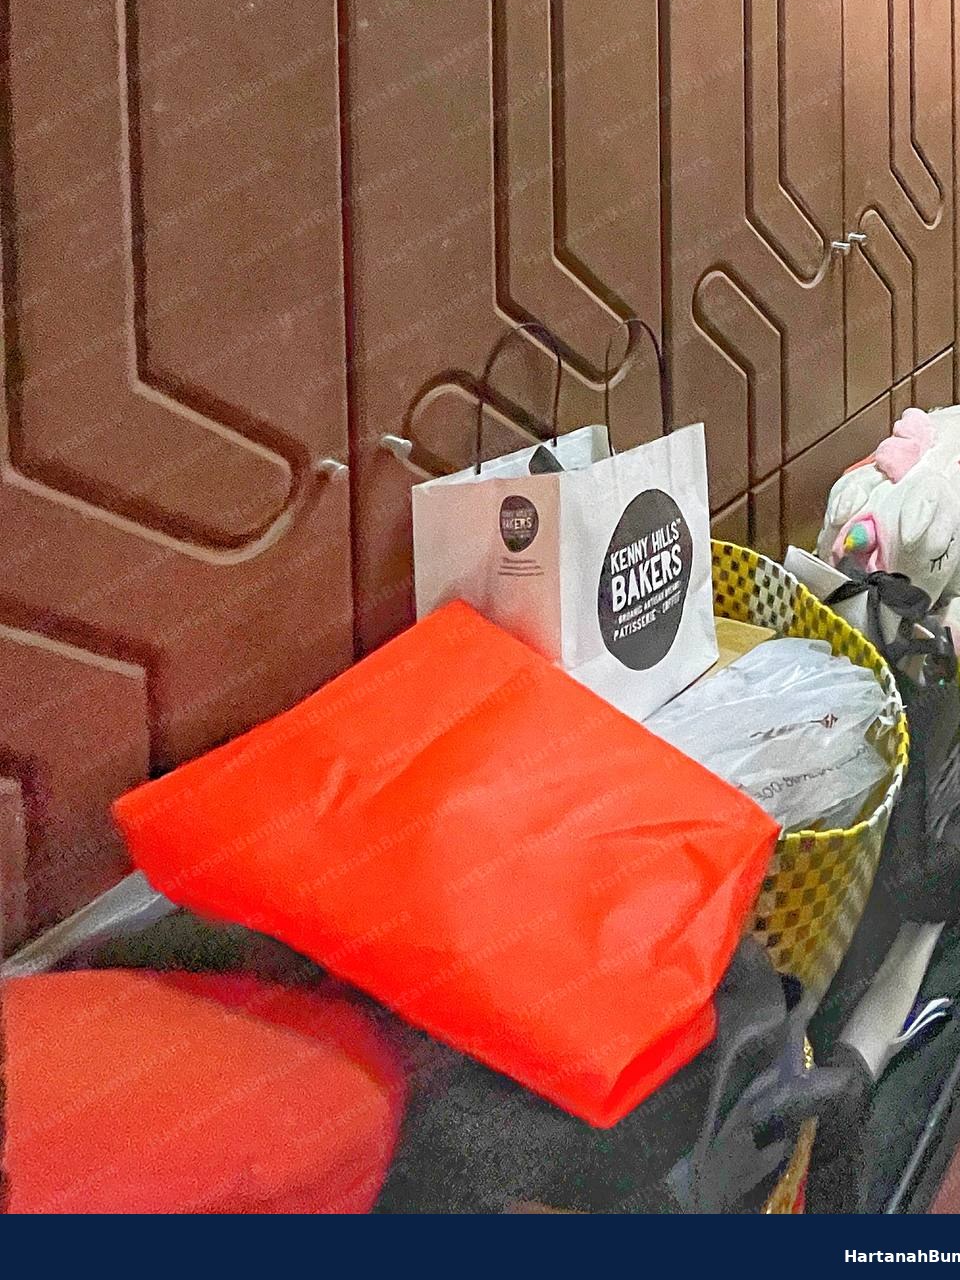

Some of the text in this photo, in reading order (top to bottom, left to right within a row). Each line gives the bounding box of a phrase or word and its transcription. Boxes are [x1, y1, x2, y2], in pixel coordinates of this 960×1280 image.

[610, 537, 649, 576] KENNY
[611, 544, 682, 613] BAKERS
[613, 608, 657, 642] PATISSERIE
